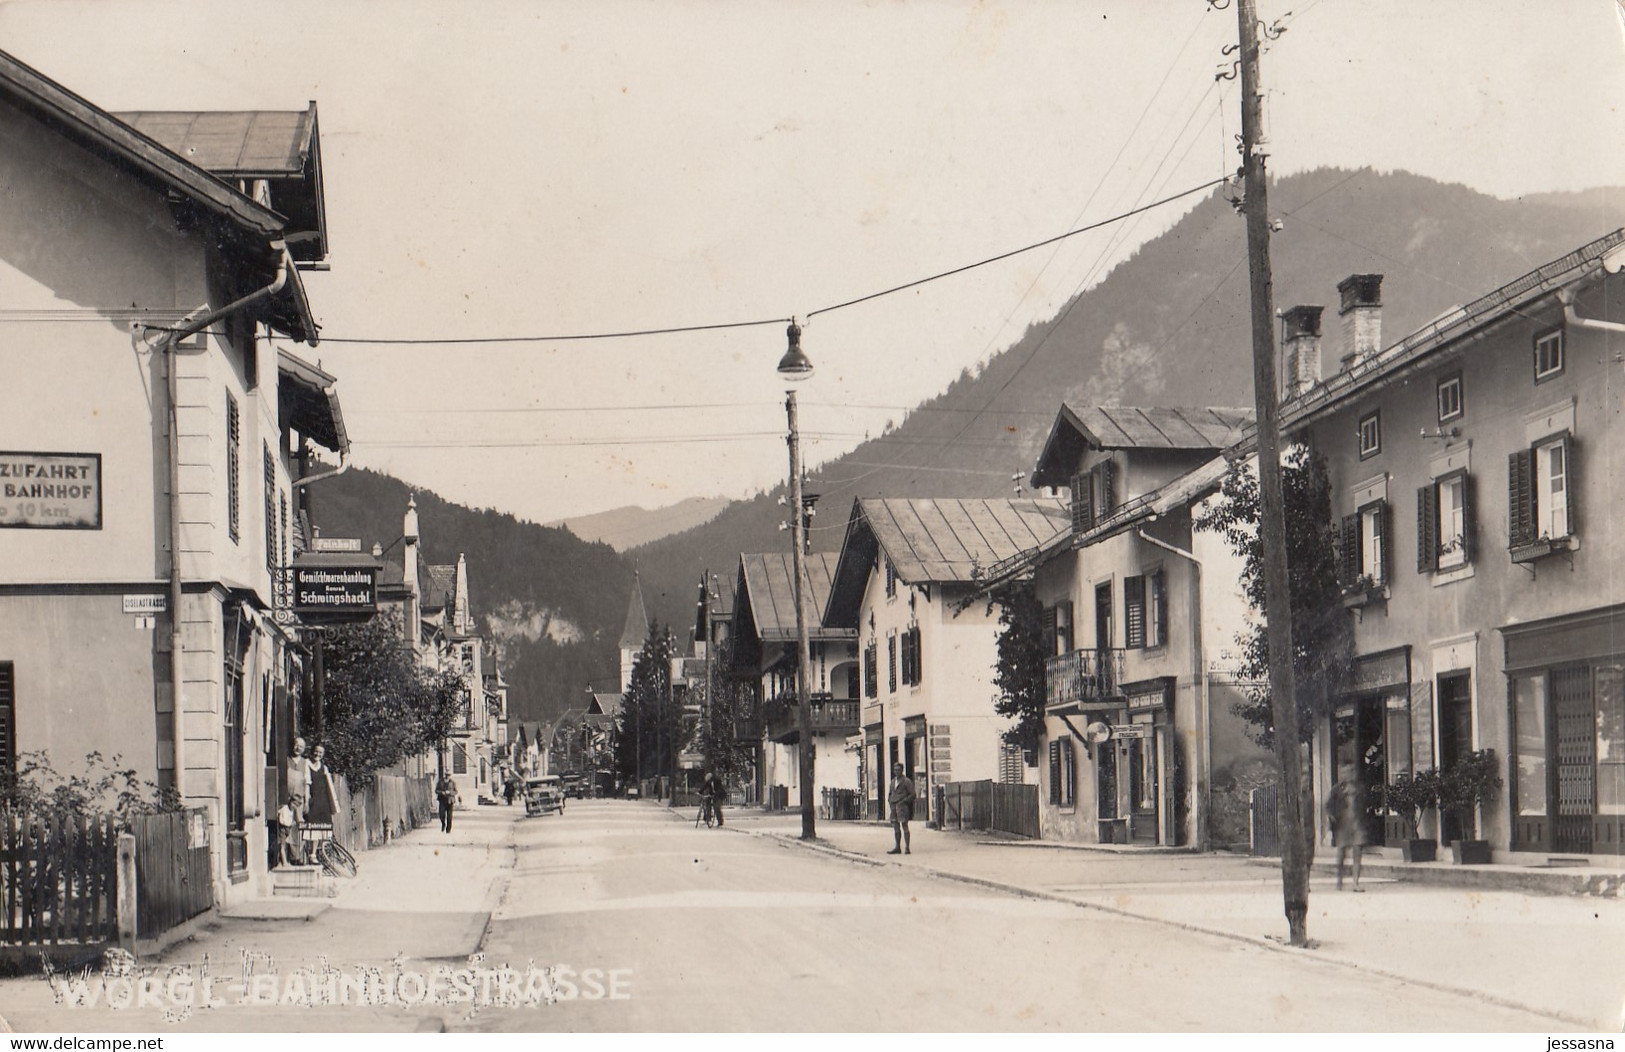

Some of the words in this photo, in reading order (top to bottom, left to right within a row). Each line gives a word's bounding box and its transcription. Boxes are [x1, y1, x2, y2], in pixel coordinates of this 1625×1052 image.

[0, 463, 90, 479] ZUFAHRT
[4, 483, 92, 499] BAHNHOF
[16, 502, 36, 517] 10
[300, 591, 370, 605] Schwingshackl
